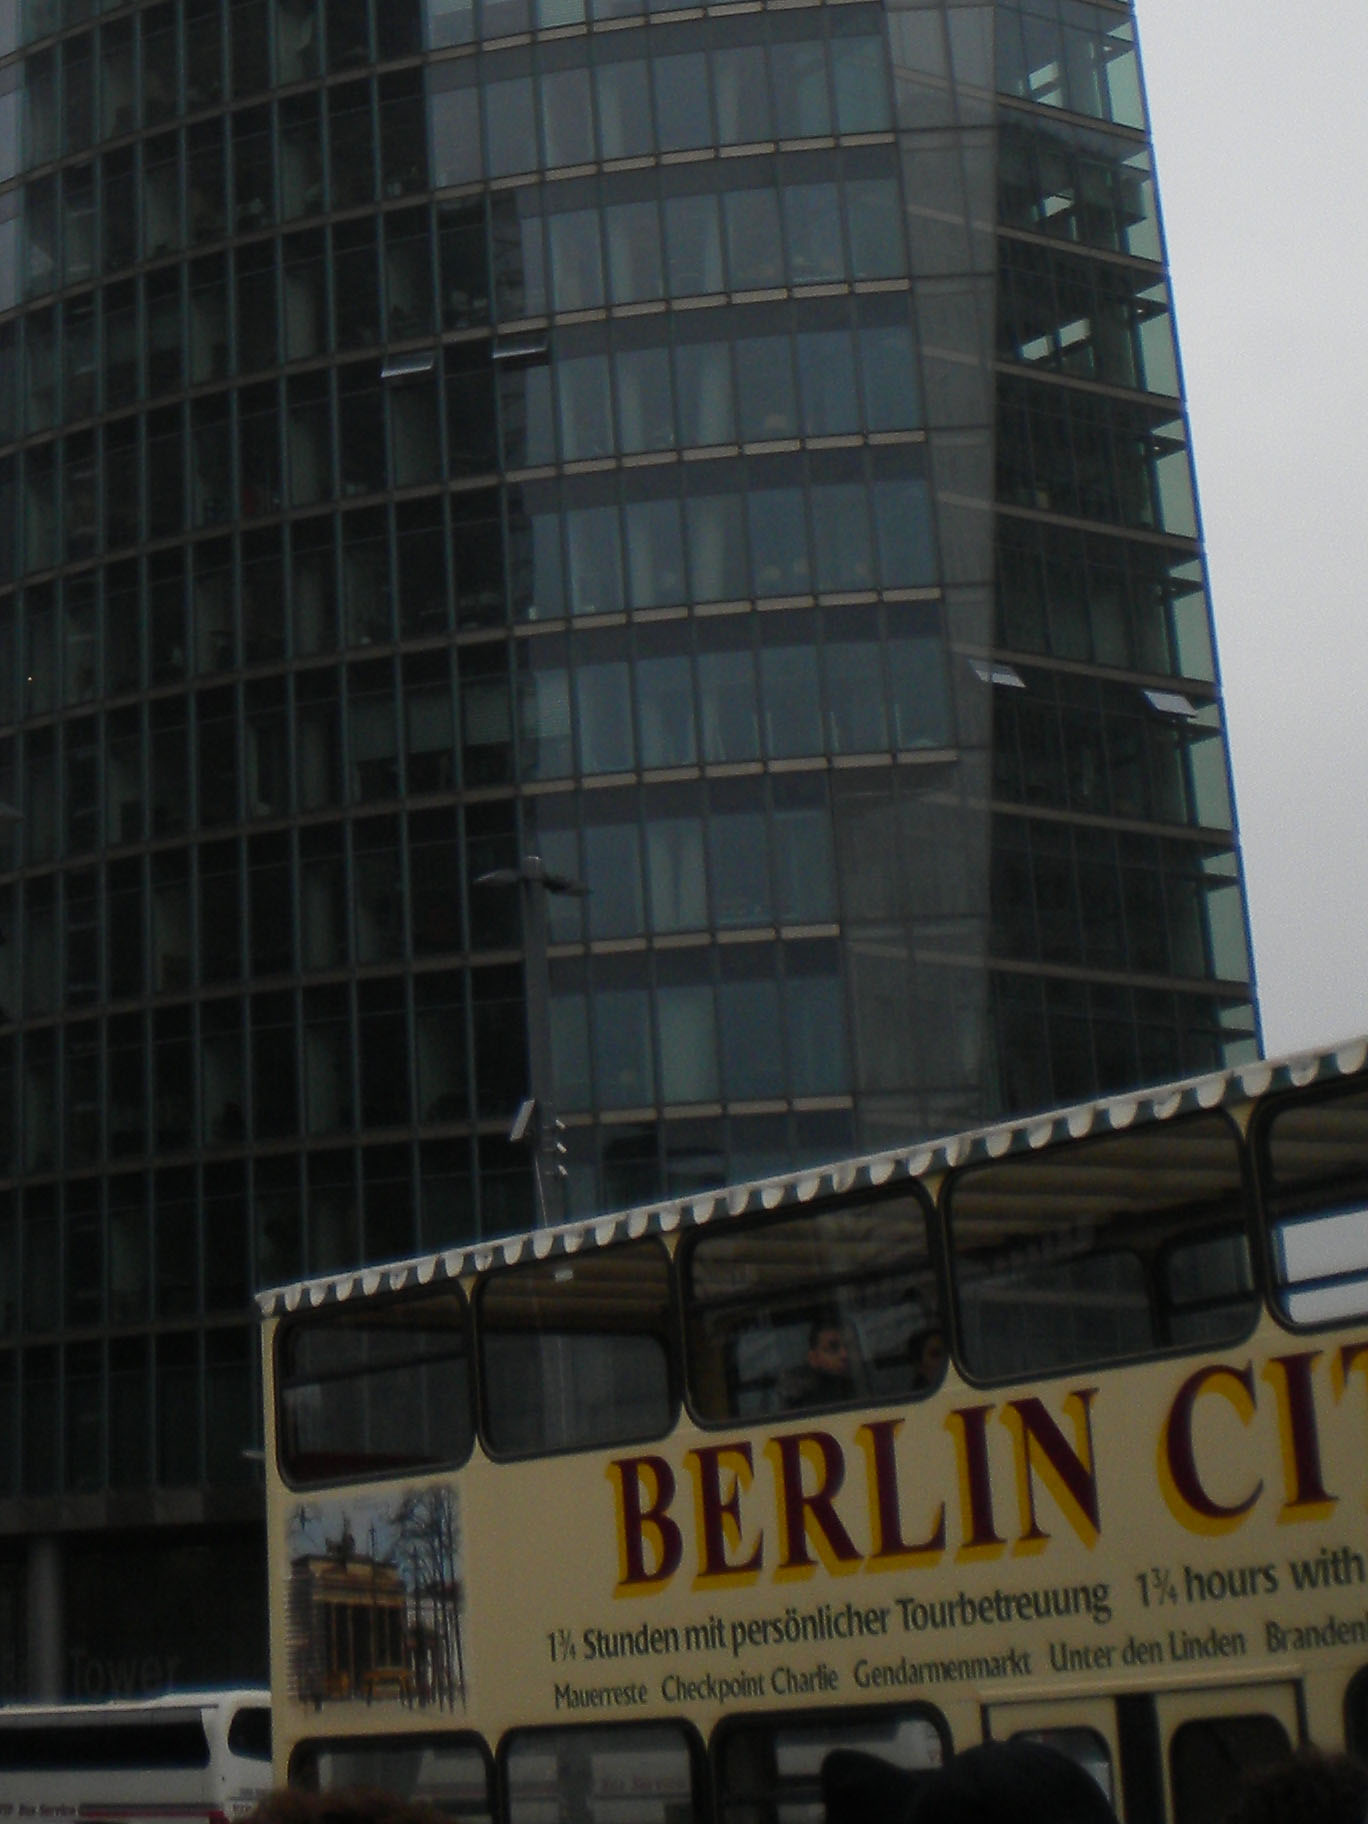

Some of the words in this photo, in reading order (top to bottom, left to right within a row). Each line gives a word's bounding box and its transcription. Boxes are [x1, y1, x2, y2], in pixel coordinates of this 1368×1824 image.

[611, 1387, 1101, 1598] BERLIN
[582, 1623, 679, 1660] Stunden
[684, 1614, 727, 1651] mit
[732, 1603, 890, 1657] persönlicher
[895, 1582, 1112, 1631] Tourbetreuung
[1184, 1566, 1279, 1603] hours
[1288, 1545, 1365, 1591] with
[554, 1682, 648, 1709] Mauerreste
[661, 1672, 765, 1704] Checkpoint
[770, 1663, 838, 1695] Charlie
[853, 1648, 1032, 1688] Gendarmenmarkt
[1049, 1642, 1115, 1672] Unter
[1121, 1635, 1163, 1666] den
[1168, 1627, 1247, 1662] Linden
[1265, 1615, 1368, 1653] Branden
